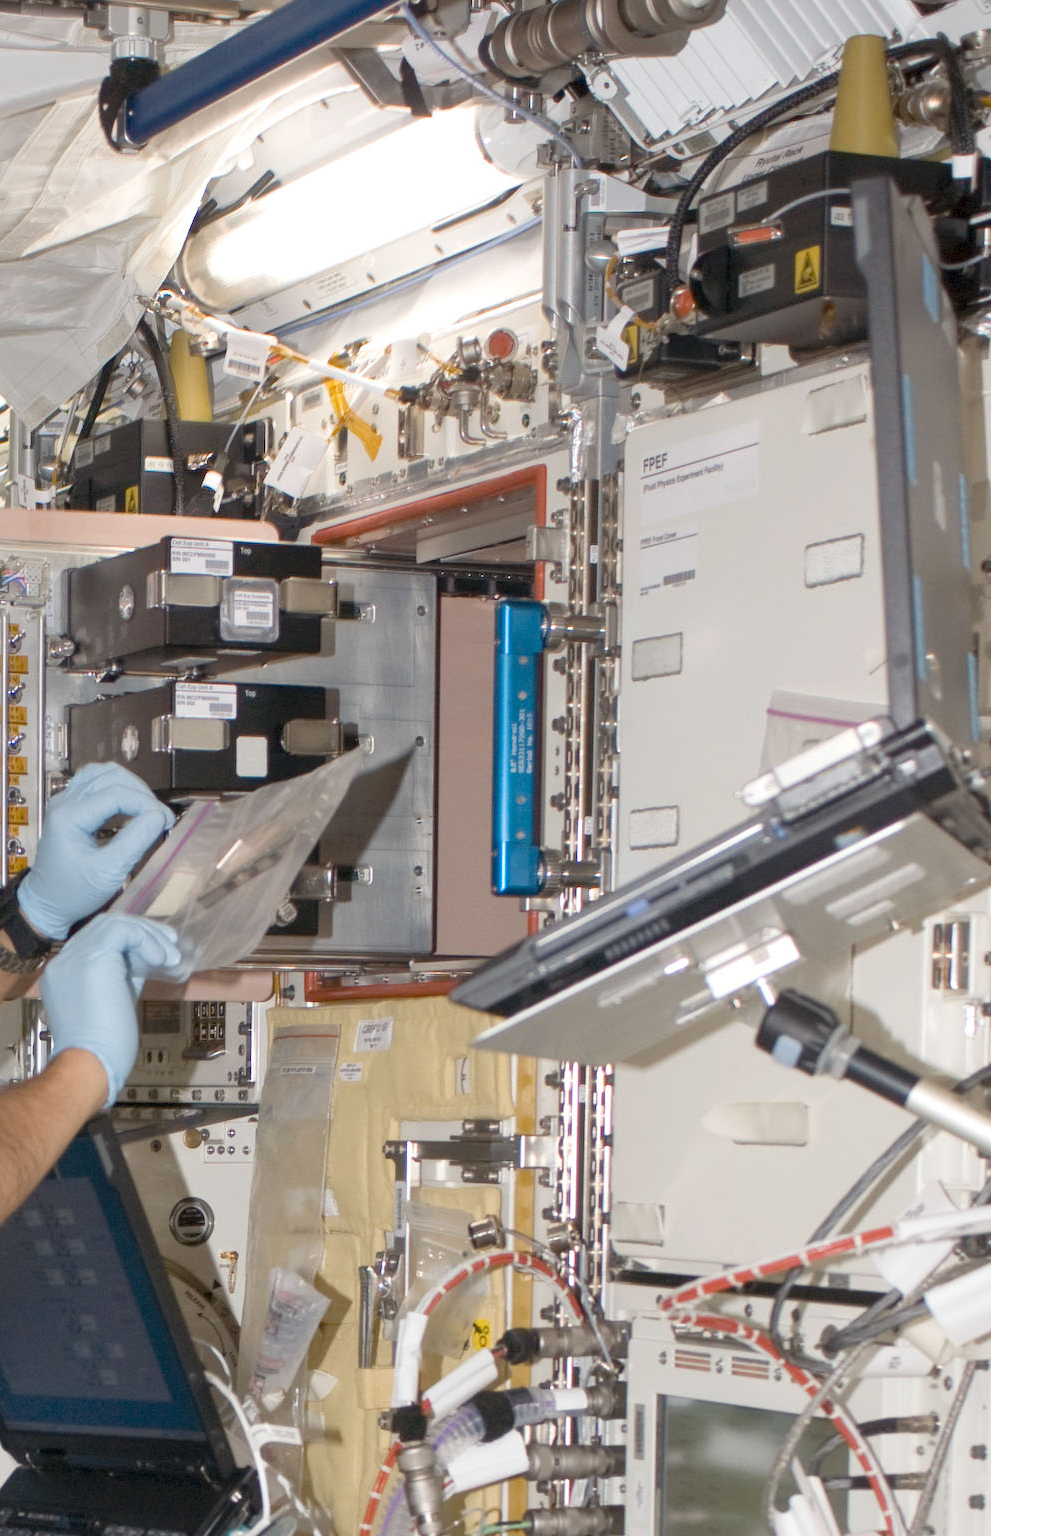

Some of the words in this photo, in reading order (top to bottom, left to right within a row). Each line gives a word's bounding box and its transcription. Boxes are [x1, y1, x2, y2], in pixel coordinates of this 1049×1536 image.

[643, 452, 668, 474] FPEF
[657, 476, 676, 489] Physics
[676, 468, 703, 483] Experiment
[240, 546, 252, 555] Top
[245, 689, 257, 699] Top
